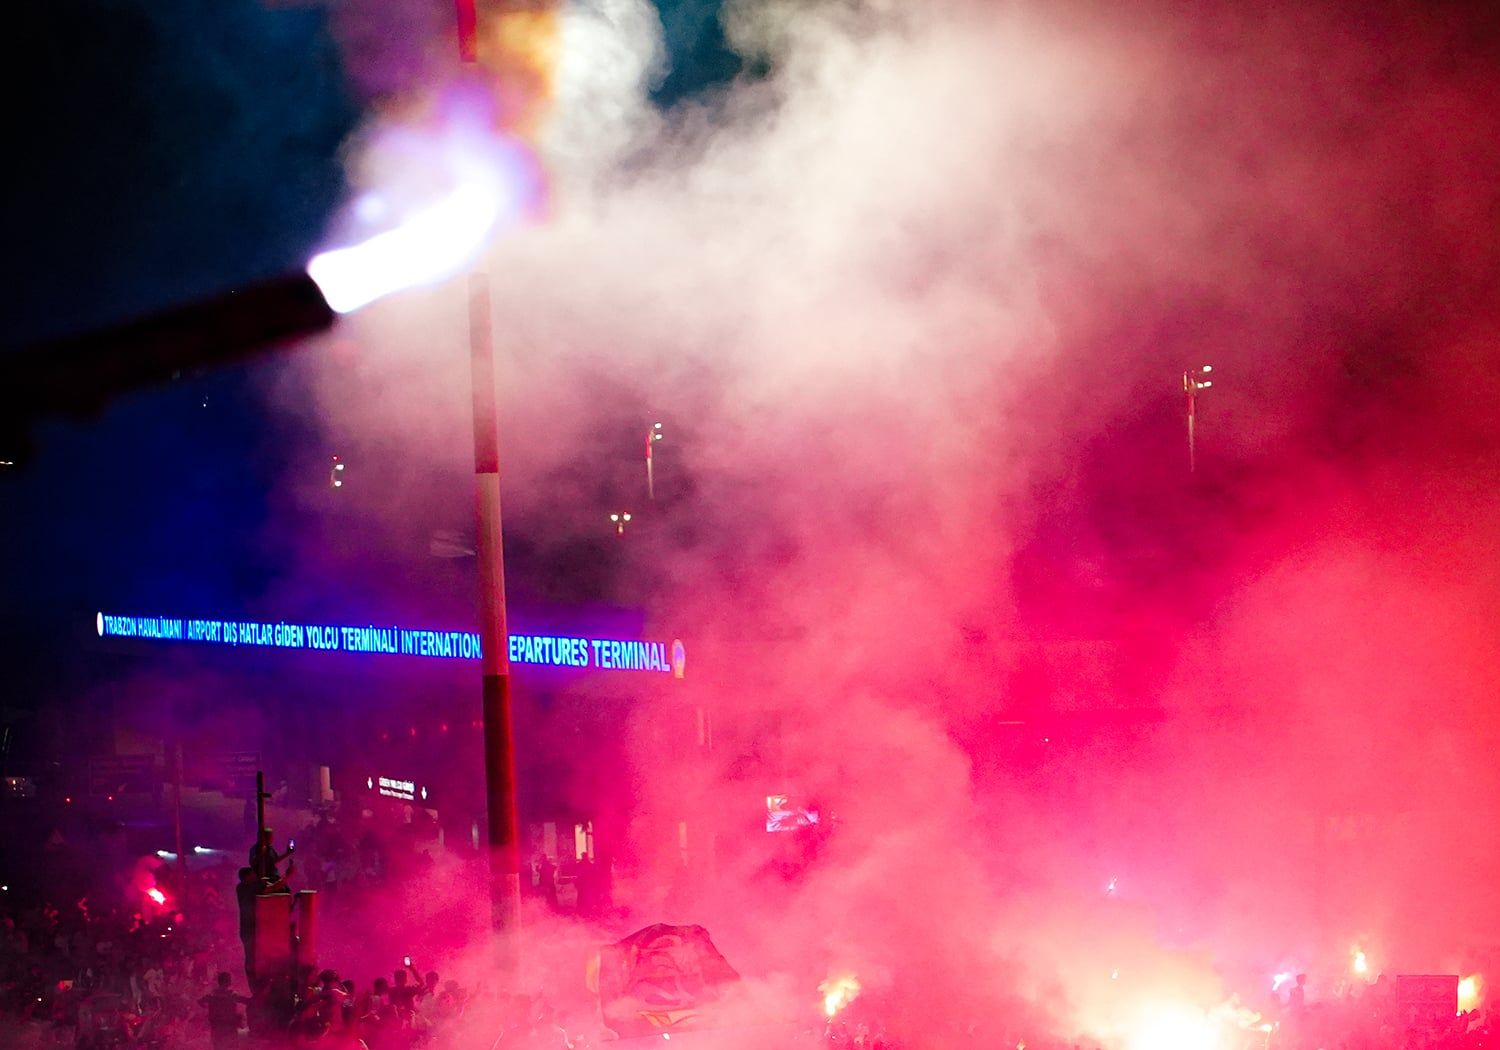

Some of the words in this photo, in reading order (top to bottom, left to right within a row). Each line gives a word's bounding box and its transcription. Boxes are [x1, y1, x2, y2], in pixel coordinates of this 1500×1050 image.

[104, 616, 137, 637] TRABZON
[138, 615, 182, 640] HAVALİMANI
[187, 619, 222, 642] AIRPORT
[223, 621, 238, 647] DIŞ
[240, 622, 274, 646] HATLAR
[274, 620, 304, 648] GİDEN
[306, 625, 339, 650] YOLCU
[340, 624, 398, 654] TERMİNALİ
[401, 629, 483, 659] INTERNATION
[508, 635, 589, 667] EPARTURES
[591, 639, 671, 672] TERMINAL
